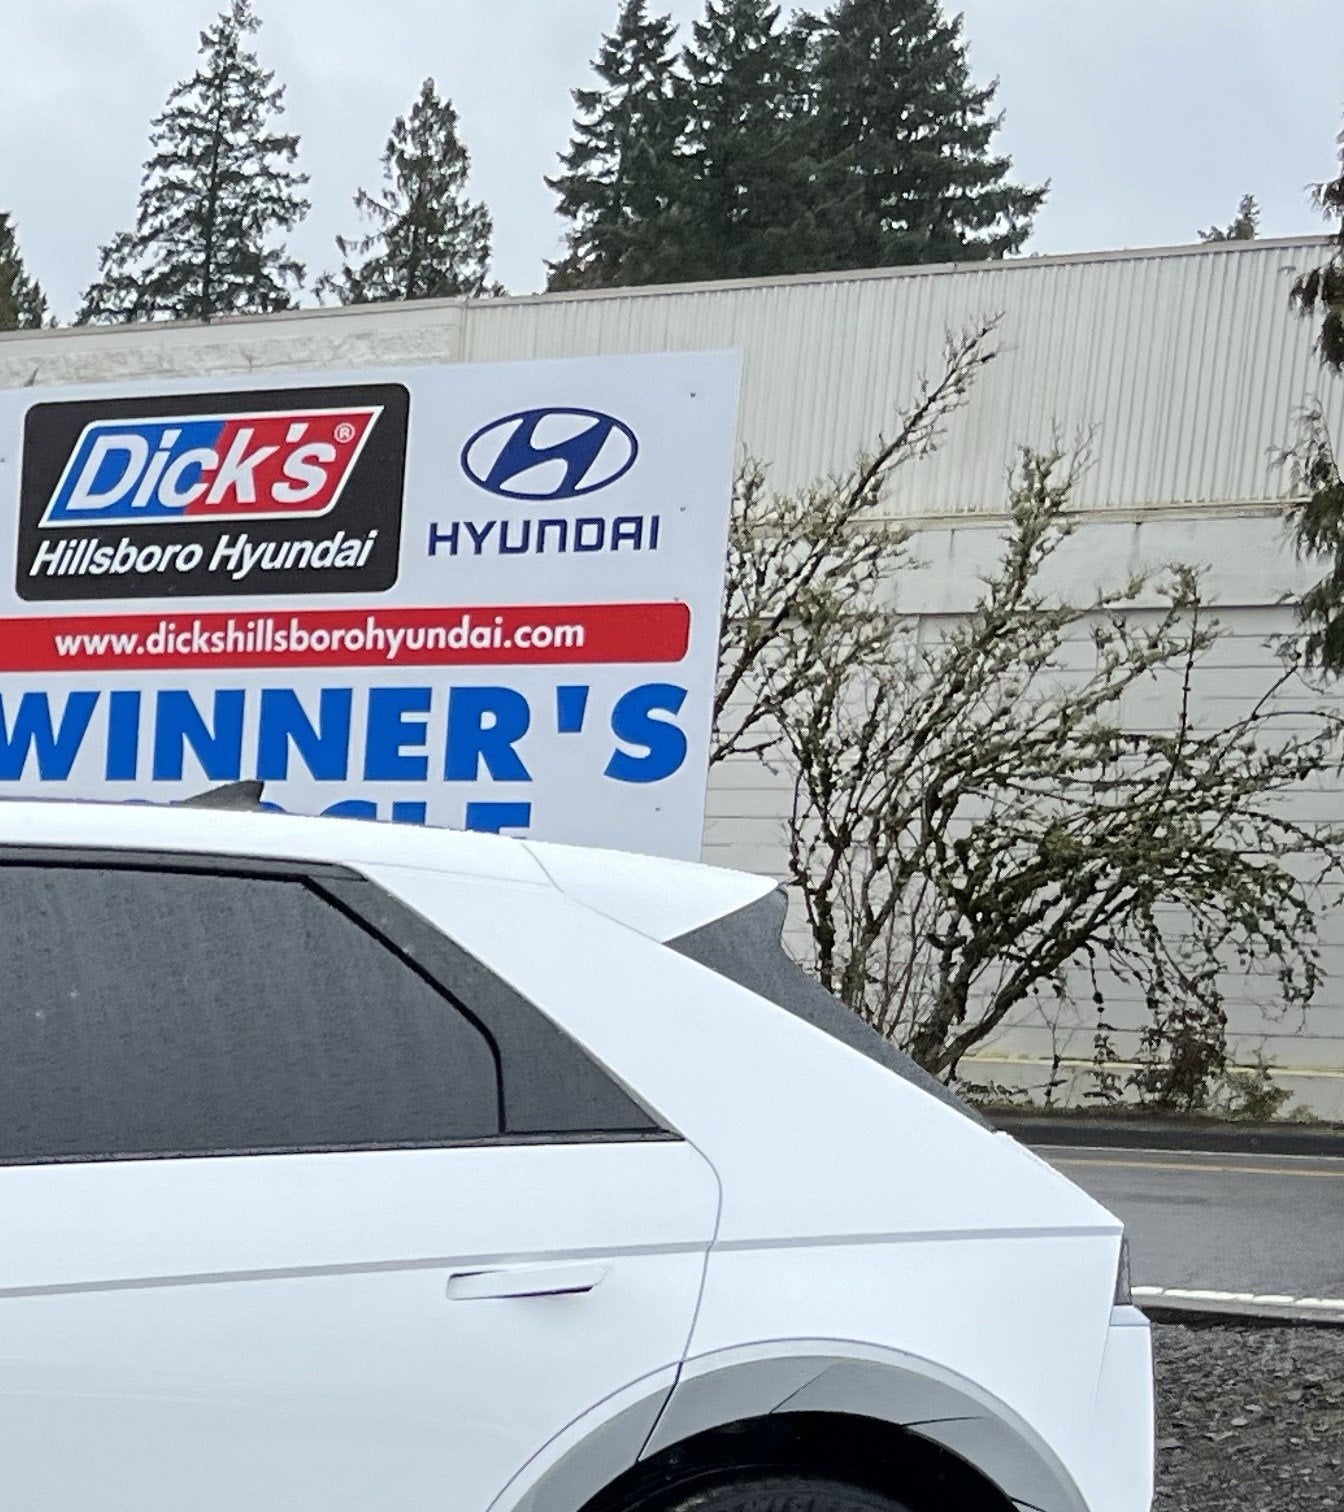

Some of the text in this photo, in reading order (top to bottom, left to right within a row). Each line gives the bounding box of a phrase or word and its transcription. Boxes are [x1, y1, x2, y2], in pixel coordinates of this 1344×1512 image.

[66, 422, 337, 511] Dick's
[29, 529, 379, 580] Hillsboro Hyundai
[428, 515, 660, 556] HYUNDAI
[54, 617, 585, 660] www.dickshillsborohyundai.com
